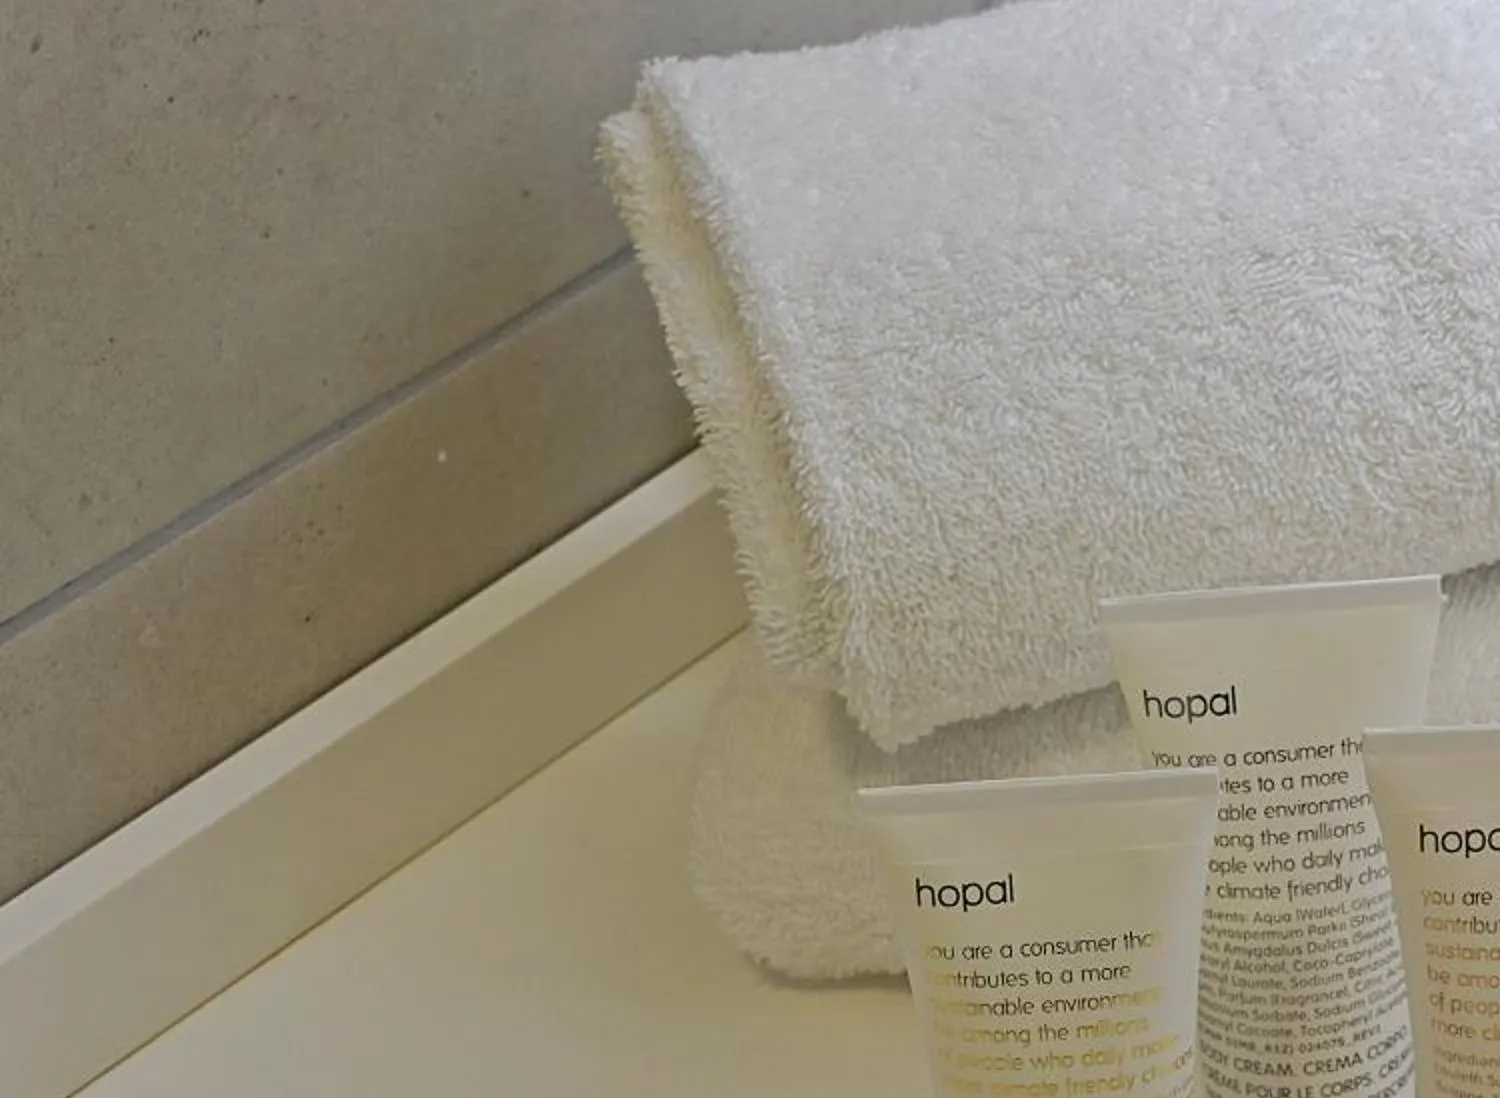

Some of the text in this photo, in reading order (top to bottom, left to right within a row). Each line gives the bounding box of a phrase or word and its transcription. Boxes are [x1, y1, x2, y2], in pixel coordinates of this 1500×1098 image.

[1143, 685, 1237, 723] hopal
[1187, 751, 1217, 768] are
[1223, 752, 1237, 767] a
[1243, 741, 1335, 767] consumer
[1257, 776, 1275, 793] to
[1281, 775, 1295, 790] a
[1301, 770, 1349, 788] more
[1264, 793, 1372, 819] environmen
[1260, 820, 1366, 847] the millions
[1253, 856, 1295, 874] who
[1302, 848, 1343, 869] daily
[915, 873, 1015, 912] hopal
[1217, 882, 1281, 899] climate
[1288, 875, 1353, 902] friendly
[1421, 889, 1456, 907] you
[1462, 889, 1493, 906] are
[961, 937, 1117, 961] are a consumer
[1035, 963, 1132, 986] to a more
[1426, 963, 1451, 984] be
[1429, 990, 1446, 1012] of
[1039, 1023, 1069, 1042] the
[1431, 1016, 1475, 1039] more
[1030, 1049, 1075, 1071] who
[1303, 1052, 1362, 1076] CREMA
